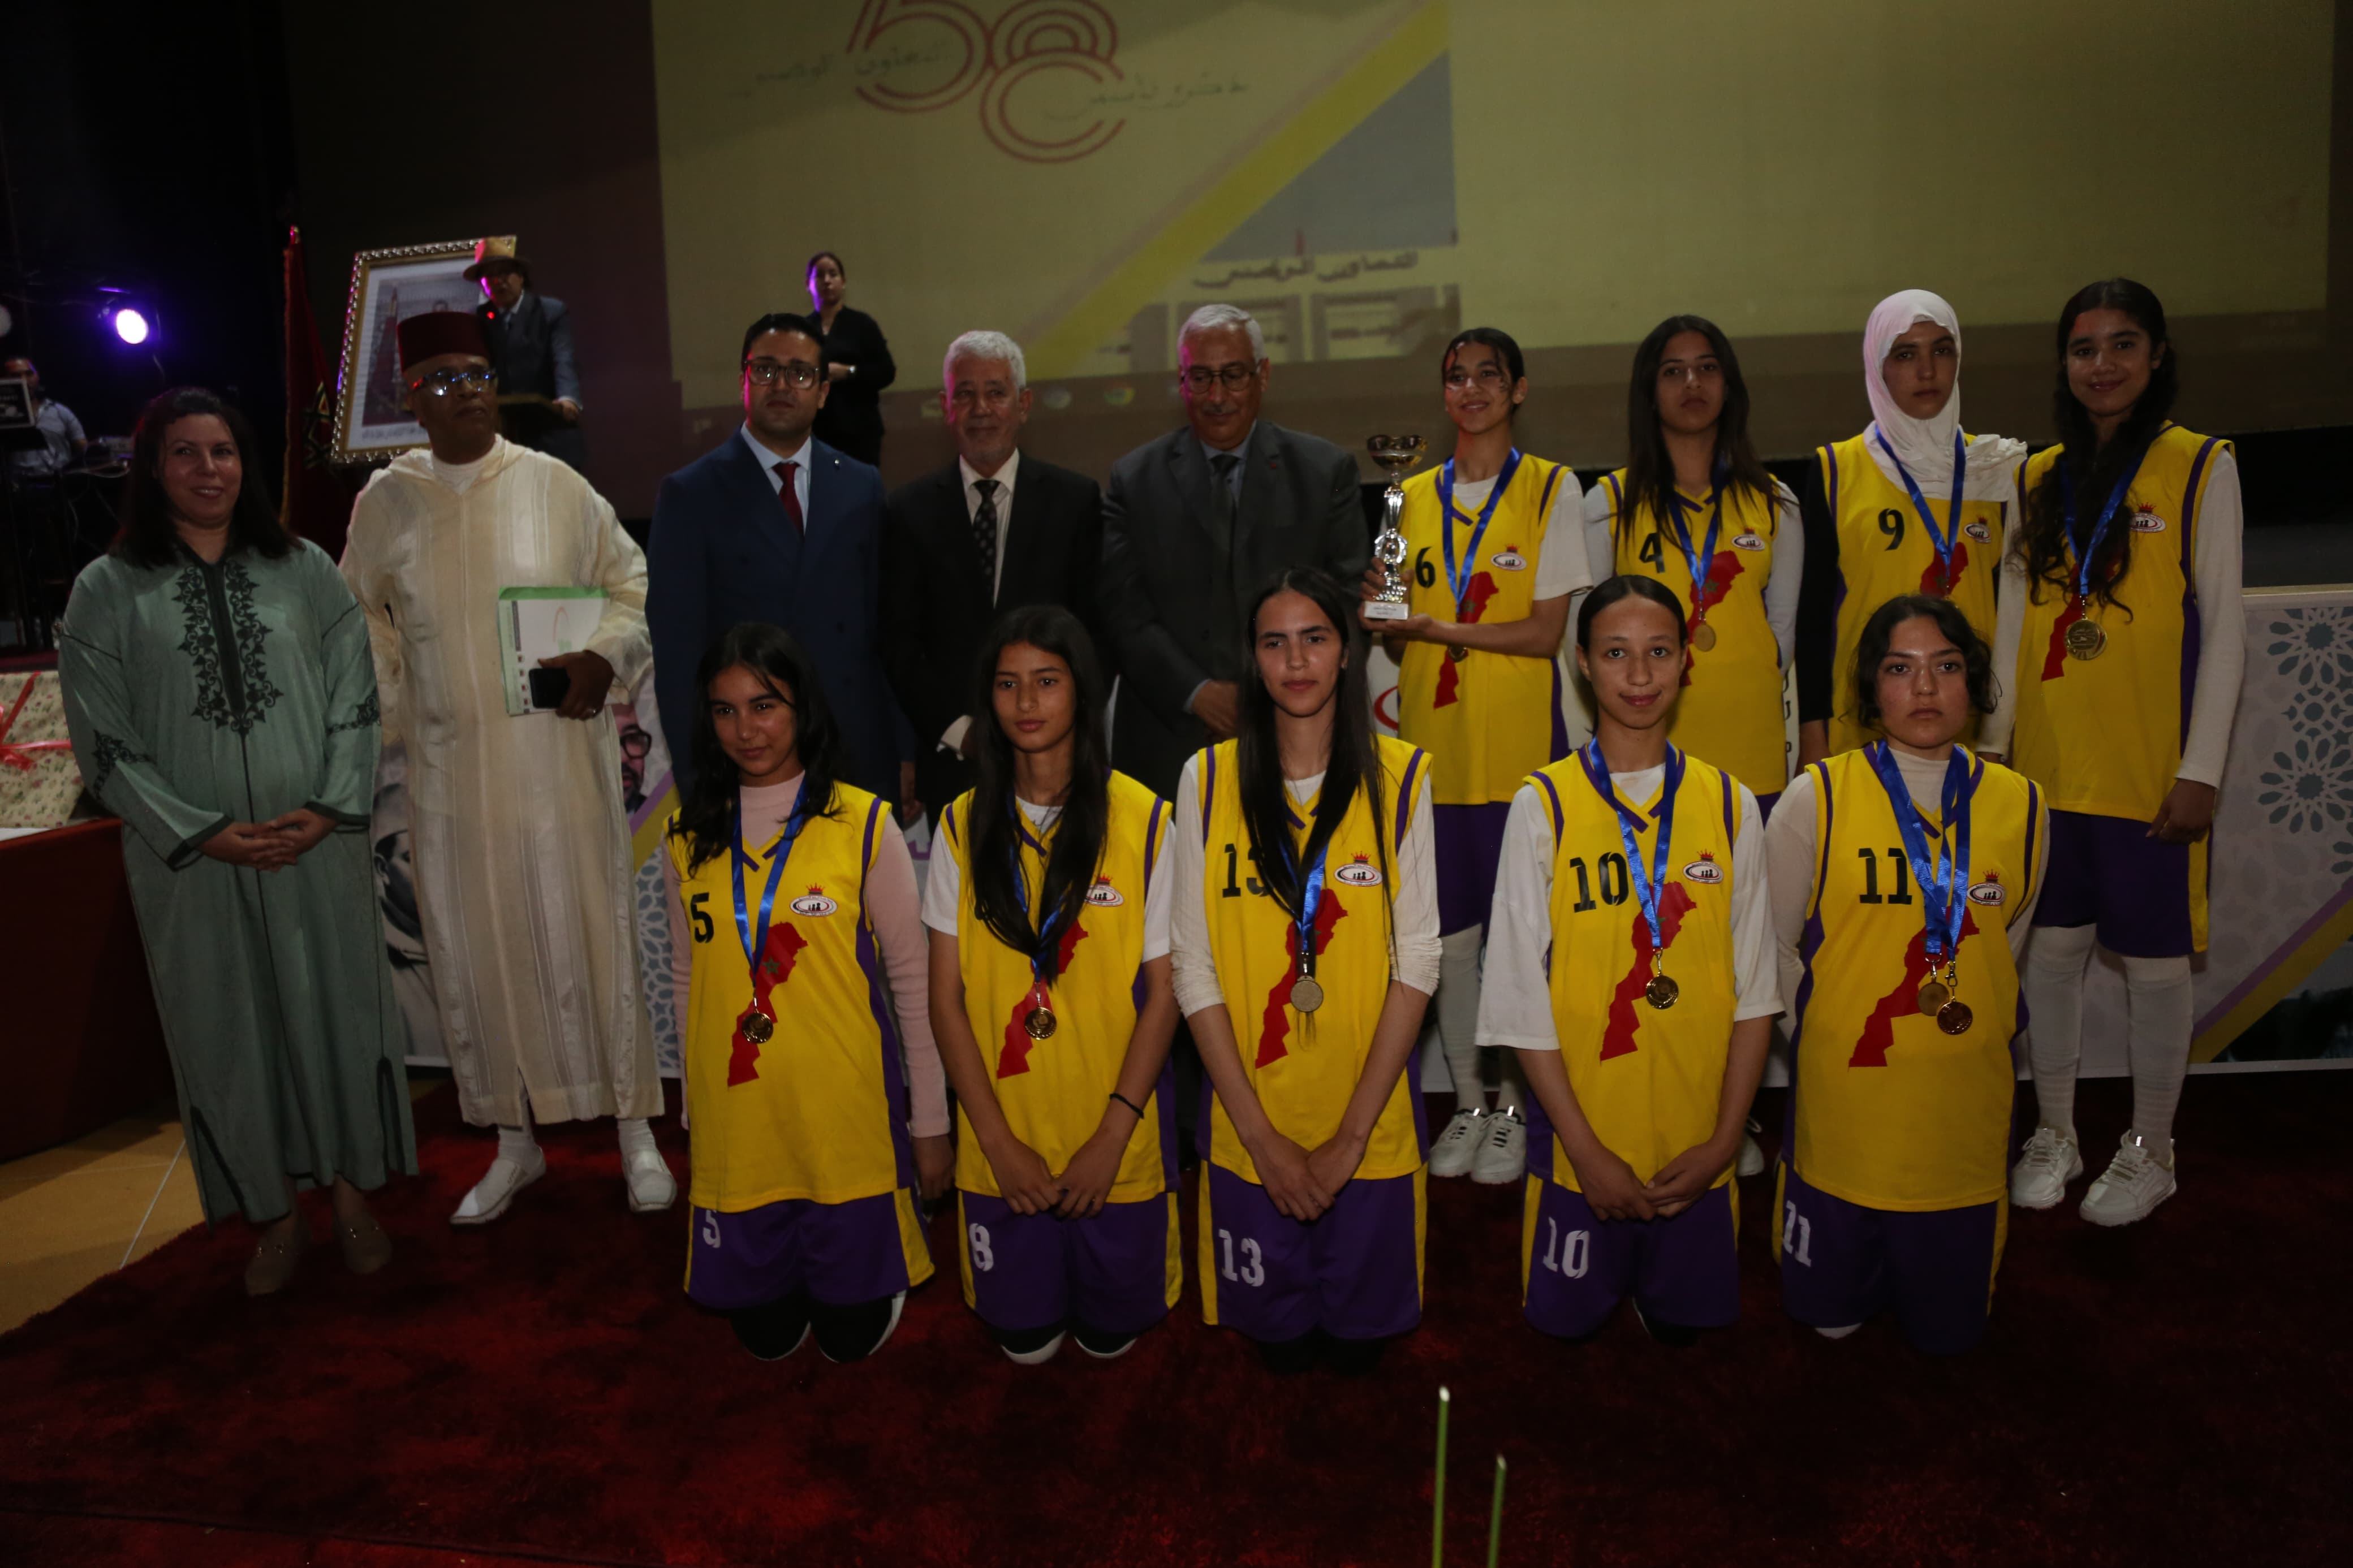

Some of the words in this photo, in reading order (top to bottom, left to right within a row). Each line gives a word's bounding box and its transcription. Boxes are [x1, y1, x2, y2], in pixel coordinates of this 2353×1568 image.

[1638, 531, 1666, 574] 4
[1878, 507, 1905, 552] 9
[1415, 546, 1436, 588] 6
[1570, 851, 1629, 913] 10
[1858, 848, 1913, 905] 11
[689, 892, 715, 944] 5
[703, 1209, 721, 1249] 5
[968, 1222, 994, 1273] 8
[1542, 1216, 1589, 1280] 10
[1782, 1199, 1812, 1267] 11
[1218, 1228, 1265, 1288] 13
